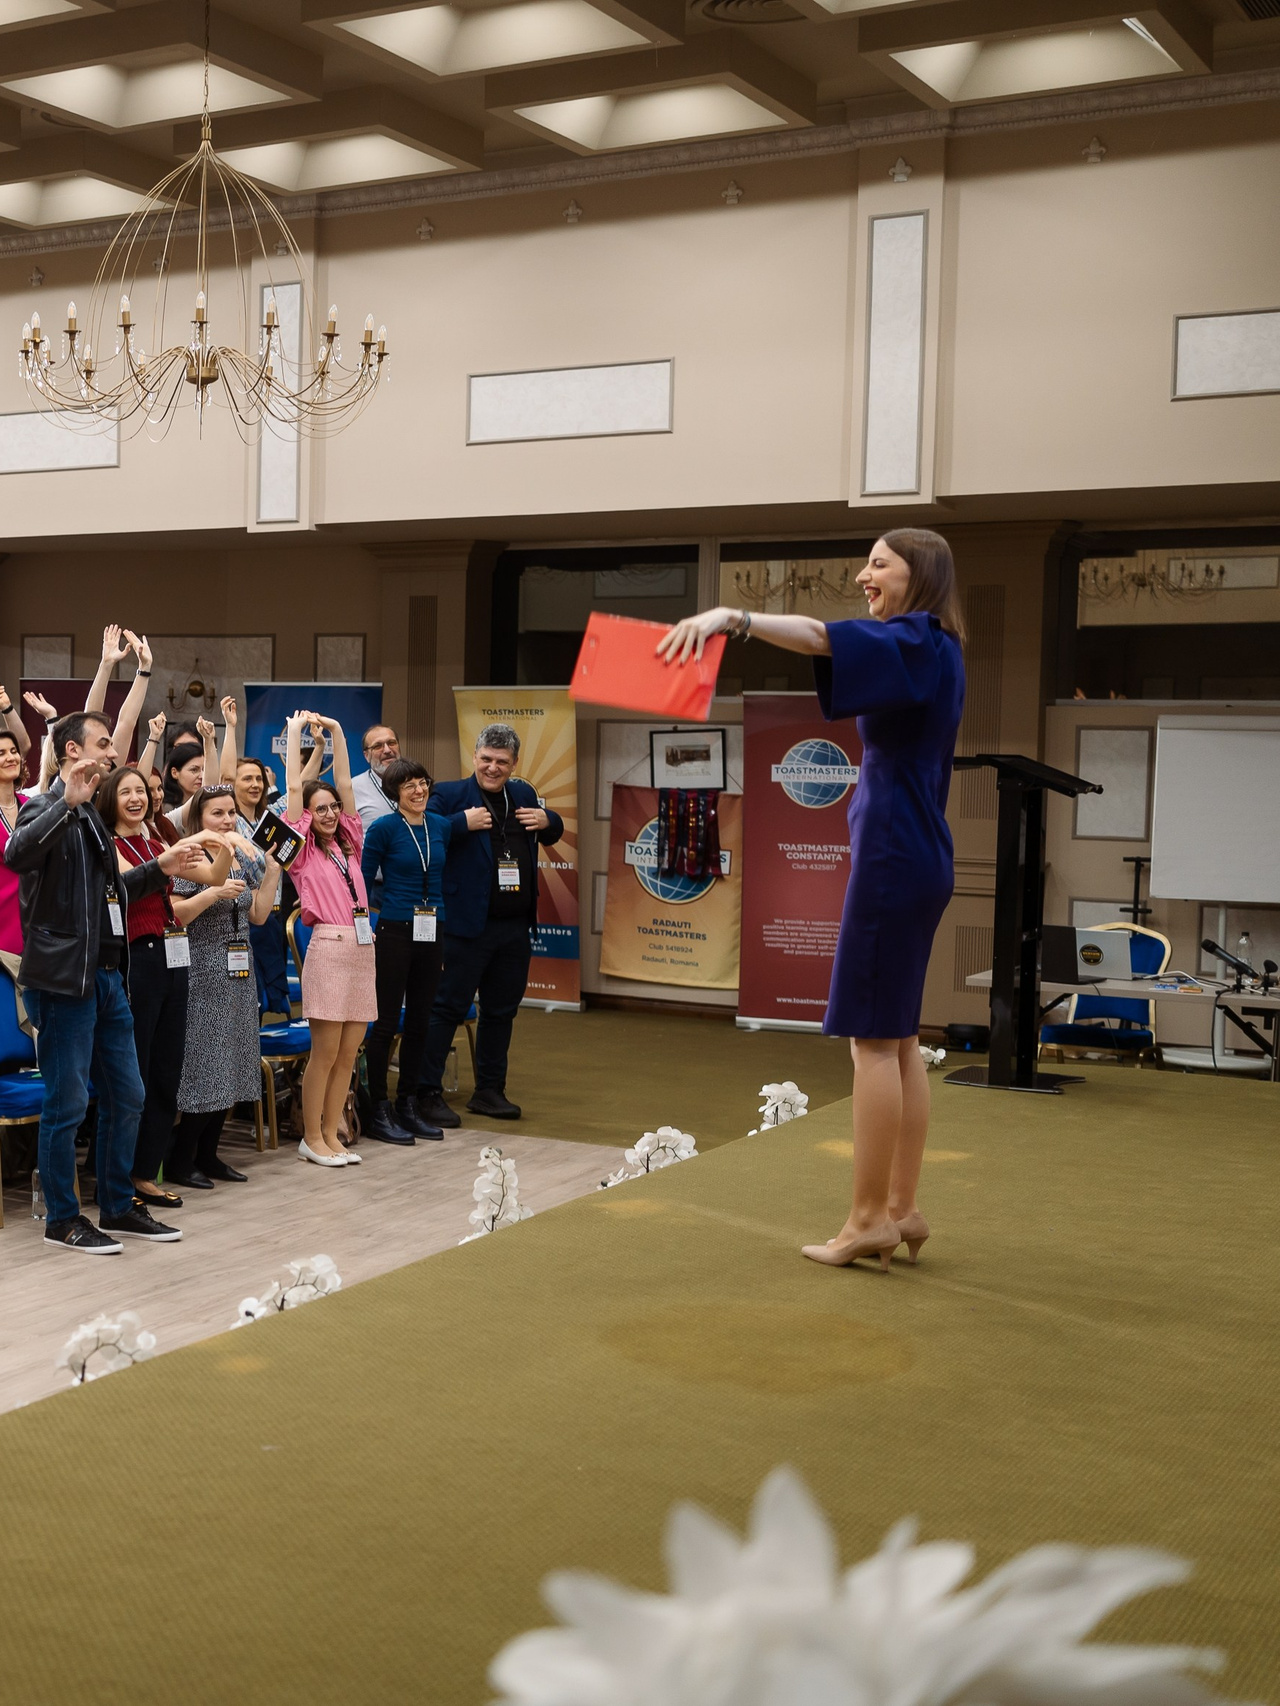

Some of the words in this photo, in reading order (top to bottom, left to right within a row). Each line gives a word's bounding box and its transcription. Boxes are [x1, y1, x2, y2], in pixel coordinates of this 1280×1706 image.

[774, 766, 858, 776] TOASTMASTERS
[778, 843, 851, 853] TOASTMASTERS
[550, 862, 574, 870] MADE
[652, 918, 692, 928] RADAUTI
[637, 926, 706, 940] TOASTMASTERS
[776, 997, 828, 1006] www.toastmaste
